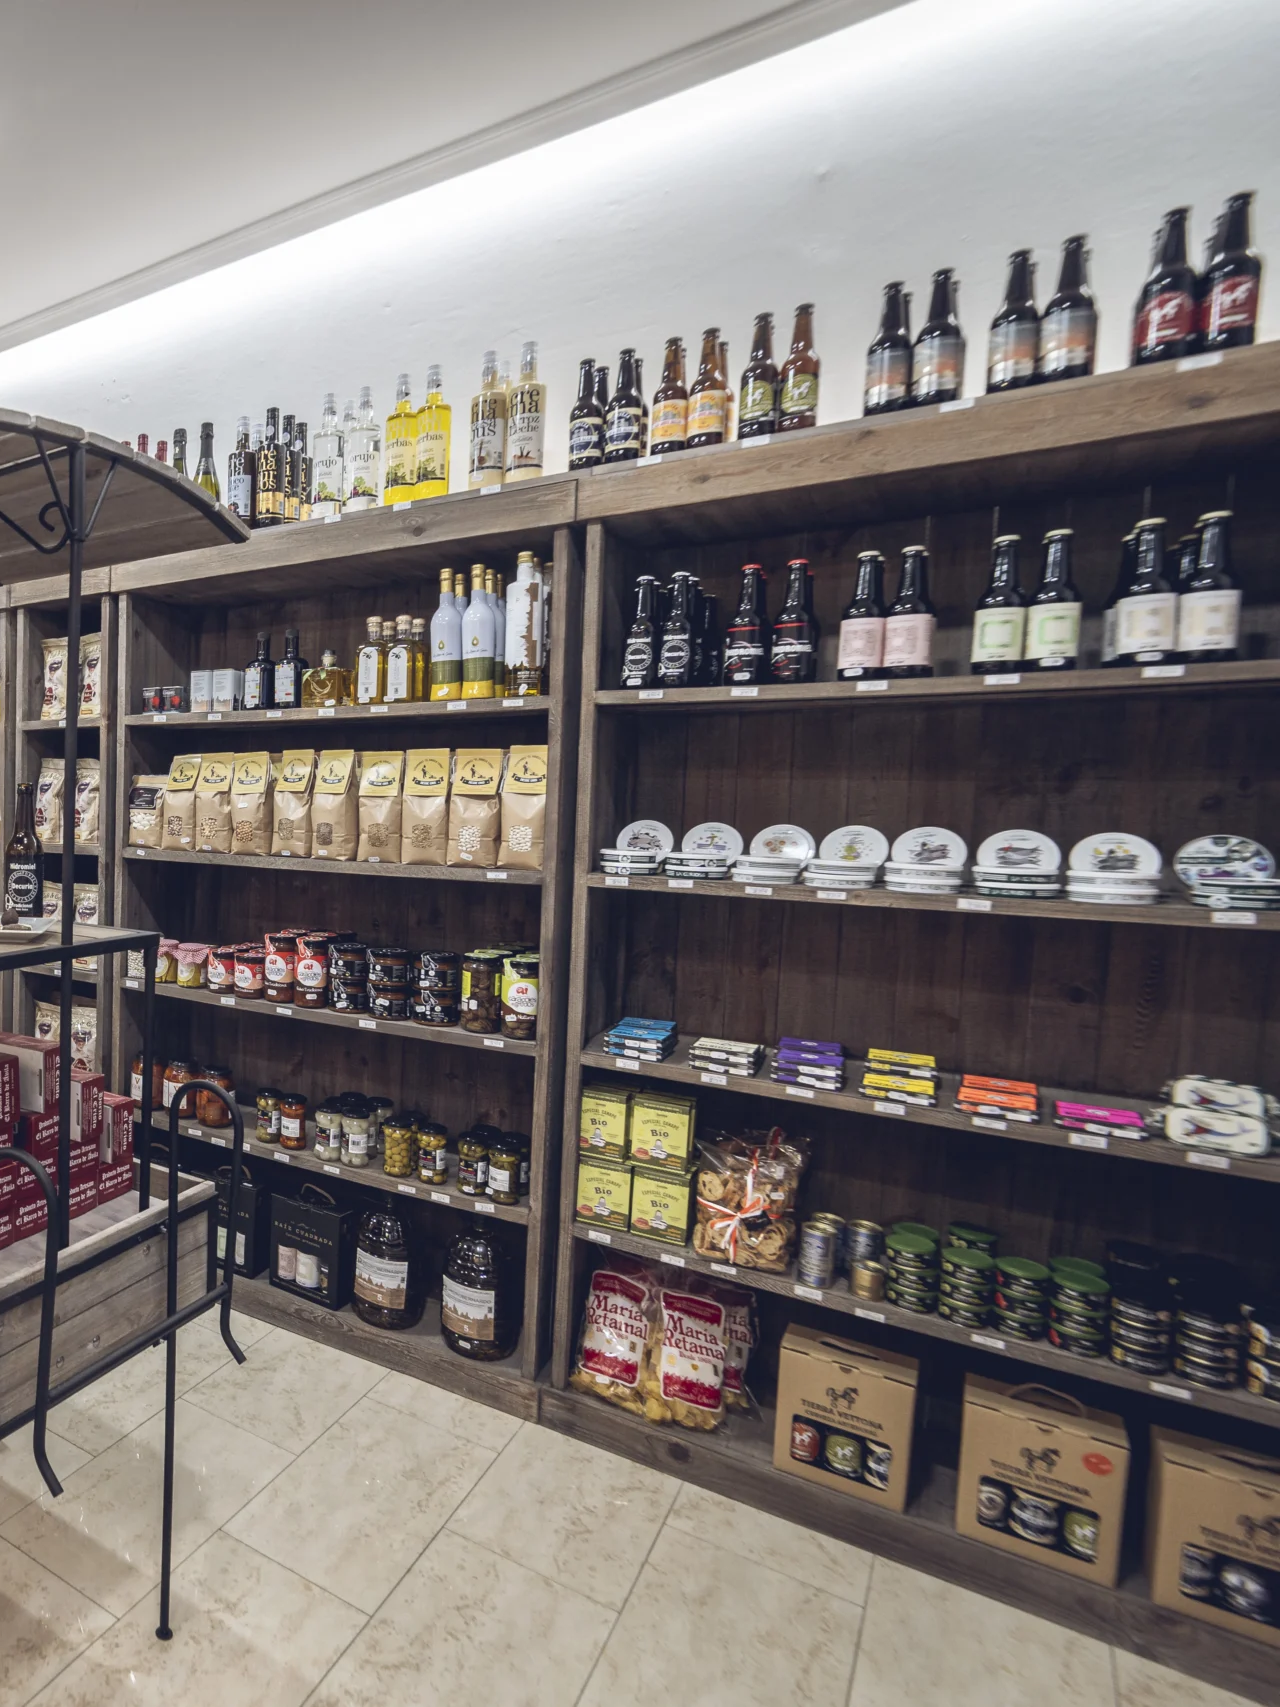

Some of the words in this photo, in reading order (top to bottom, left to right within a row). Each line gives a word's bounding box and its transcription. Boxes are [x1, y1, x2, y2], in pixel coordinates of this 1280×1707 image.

[350, 450, 375, 463] orujo
[99, 1182, 105, 1190] El
[295, 1228, 333, 1246] CUADRADA
[591, 1294, 644, 1323] María
[587, 1307, 648, 1341] Retamal
[665, 1313, 718, 1346] María
[800, 1398, 835, 1416] TIERRA
[836, 1410, 884, 1431] VETTONA
